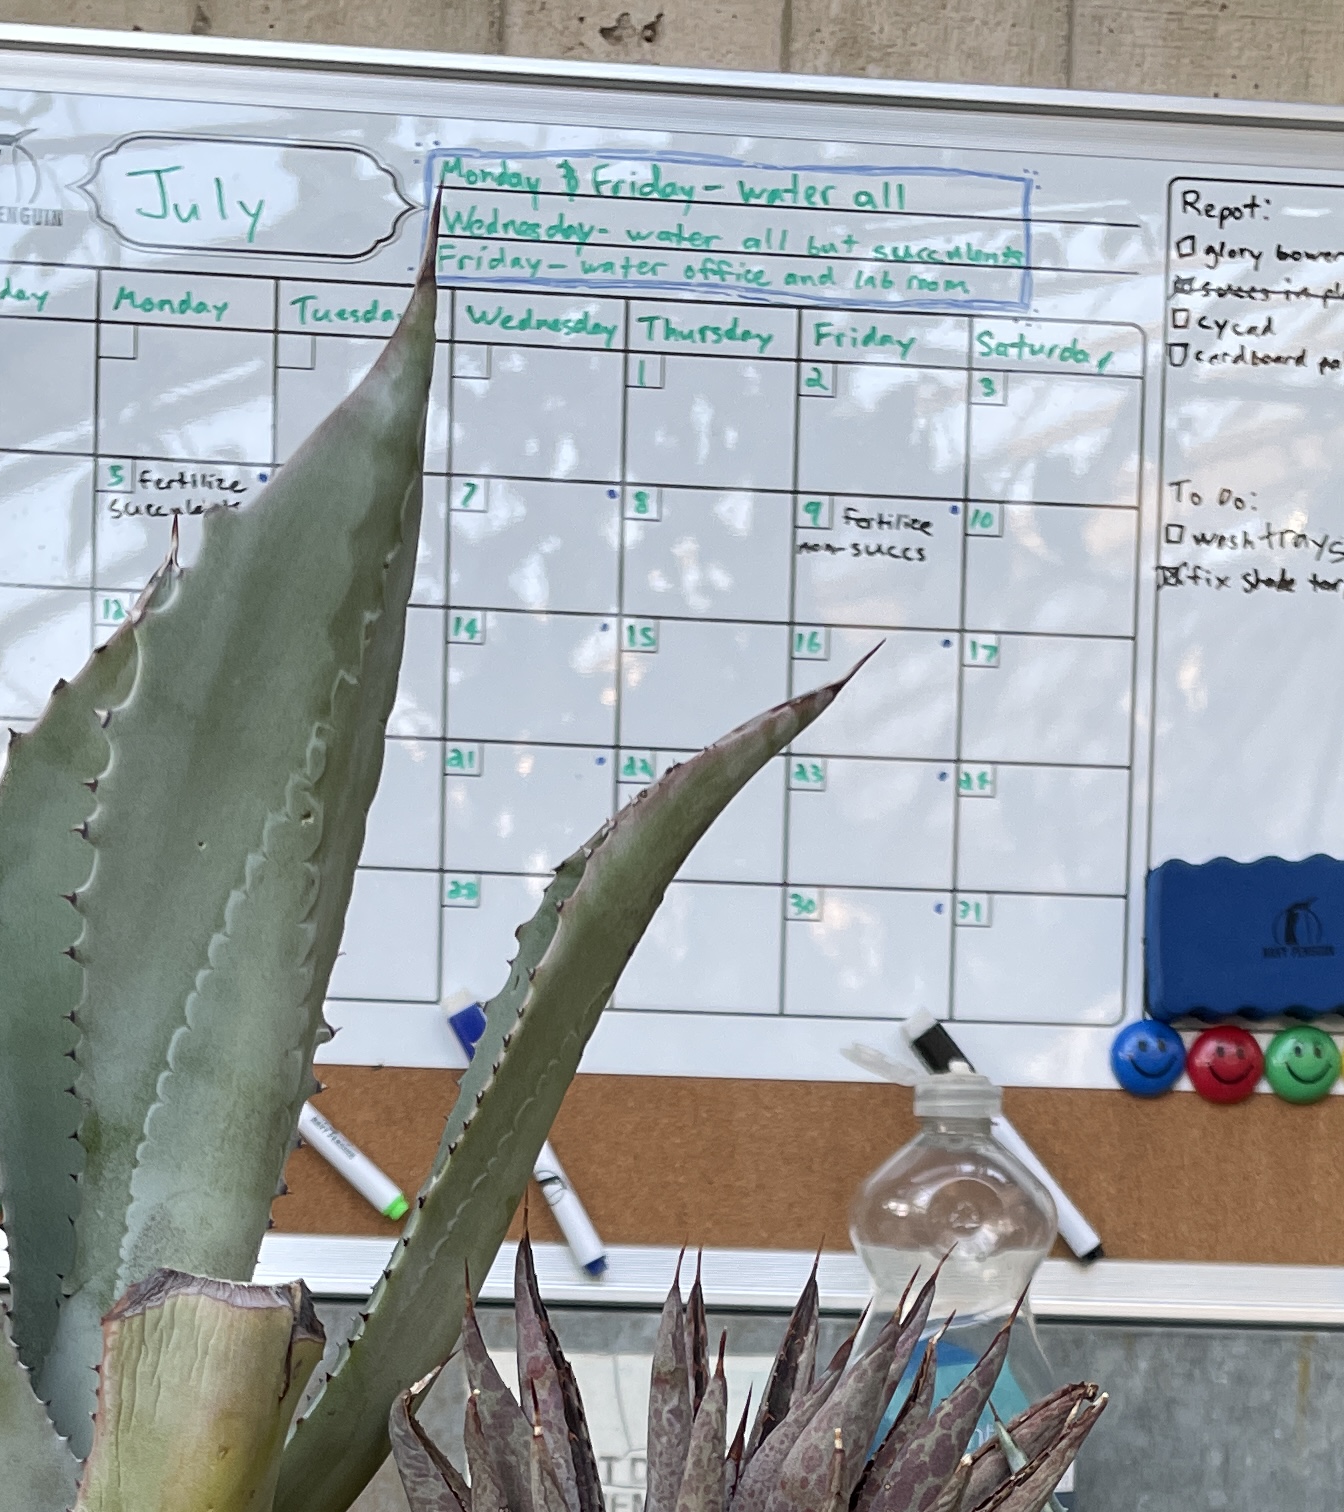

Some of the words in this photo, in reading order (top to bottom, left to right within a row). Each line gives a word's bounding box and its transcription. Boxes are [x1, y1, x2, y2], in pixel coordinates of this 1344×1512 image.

[441, 157, 541, 211] Monday
[737, 173, 836, 206] water
[853, 181, 906, 210] all
[126, 165, 266, 243] July
[1182, 190, 1271, 229] Repot:
[626, 223, 723, 248] water
[743, 228, 788, 251] all
[807, 235, 860, 256] but
[1204, 241, 1263, 271] glory
[580, 257, 669, 279] water
[683, 257, 771, 287] office
[784, 266, 836, 286] and
[855, 270, 895, 290] lab
[112, 286, 229, 322] Monday
[292, 295, 402, 326] Tuesda
[466, 305, 618, 349] Wednesday
[636, 316, 774, 354] Thursday
[1198, 316, 1275, 339] cycad
[812, 321, 916, 360] Friday
[976, 330, 1114, 375] Saturday
[805, 367, 828, 391] 2
[980, 377, 996, 398] 3
[108, 465, 125, 488] 5
[462, 482, 479, 508] 7
[634, 490, 650, 516] 8
[1168, 479, 1202, 506] To
[802, 501, 822, 528] 9
[969, 507, 994, 530] 10
[102, 599, 126, 620] 12
[454, 614, 479, 640] 14
[627, 625, 656, 648] 15
[794, 630, 822, 654] 16
[969, 639, 998, 662] 17
[446, 750, 476, 771] 21
[793, 761, 825, 784] 23
[790, 894, 816, 917] 30
[958, 901, 984, 923] 31
